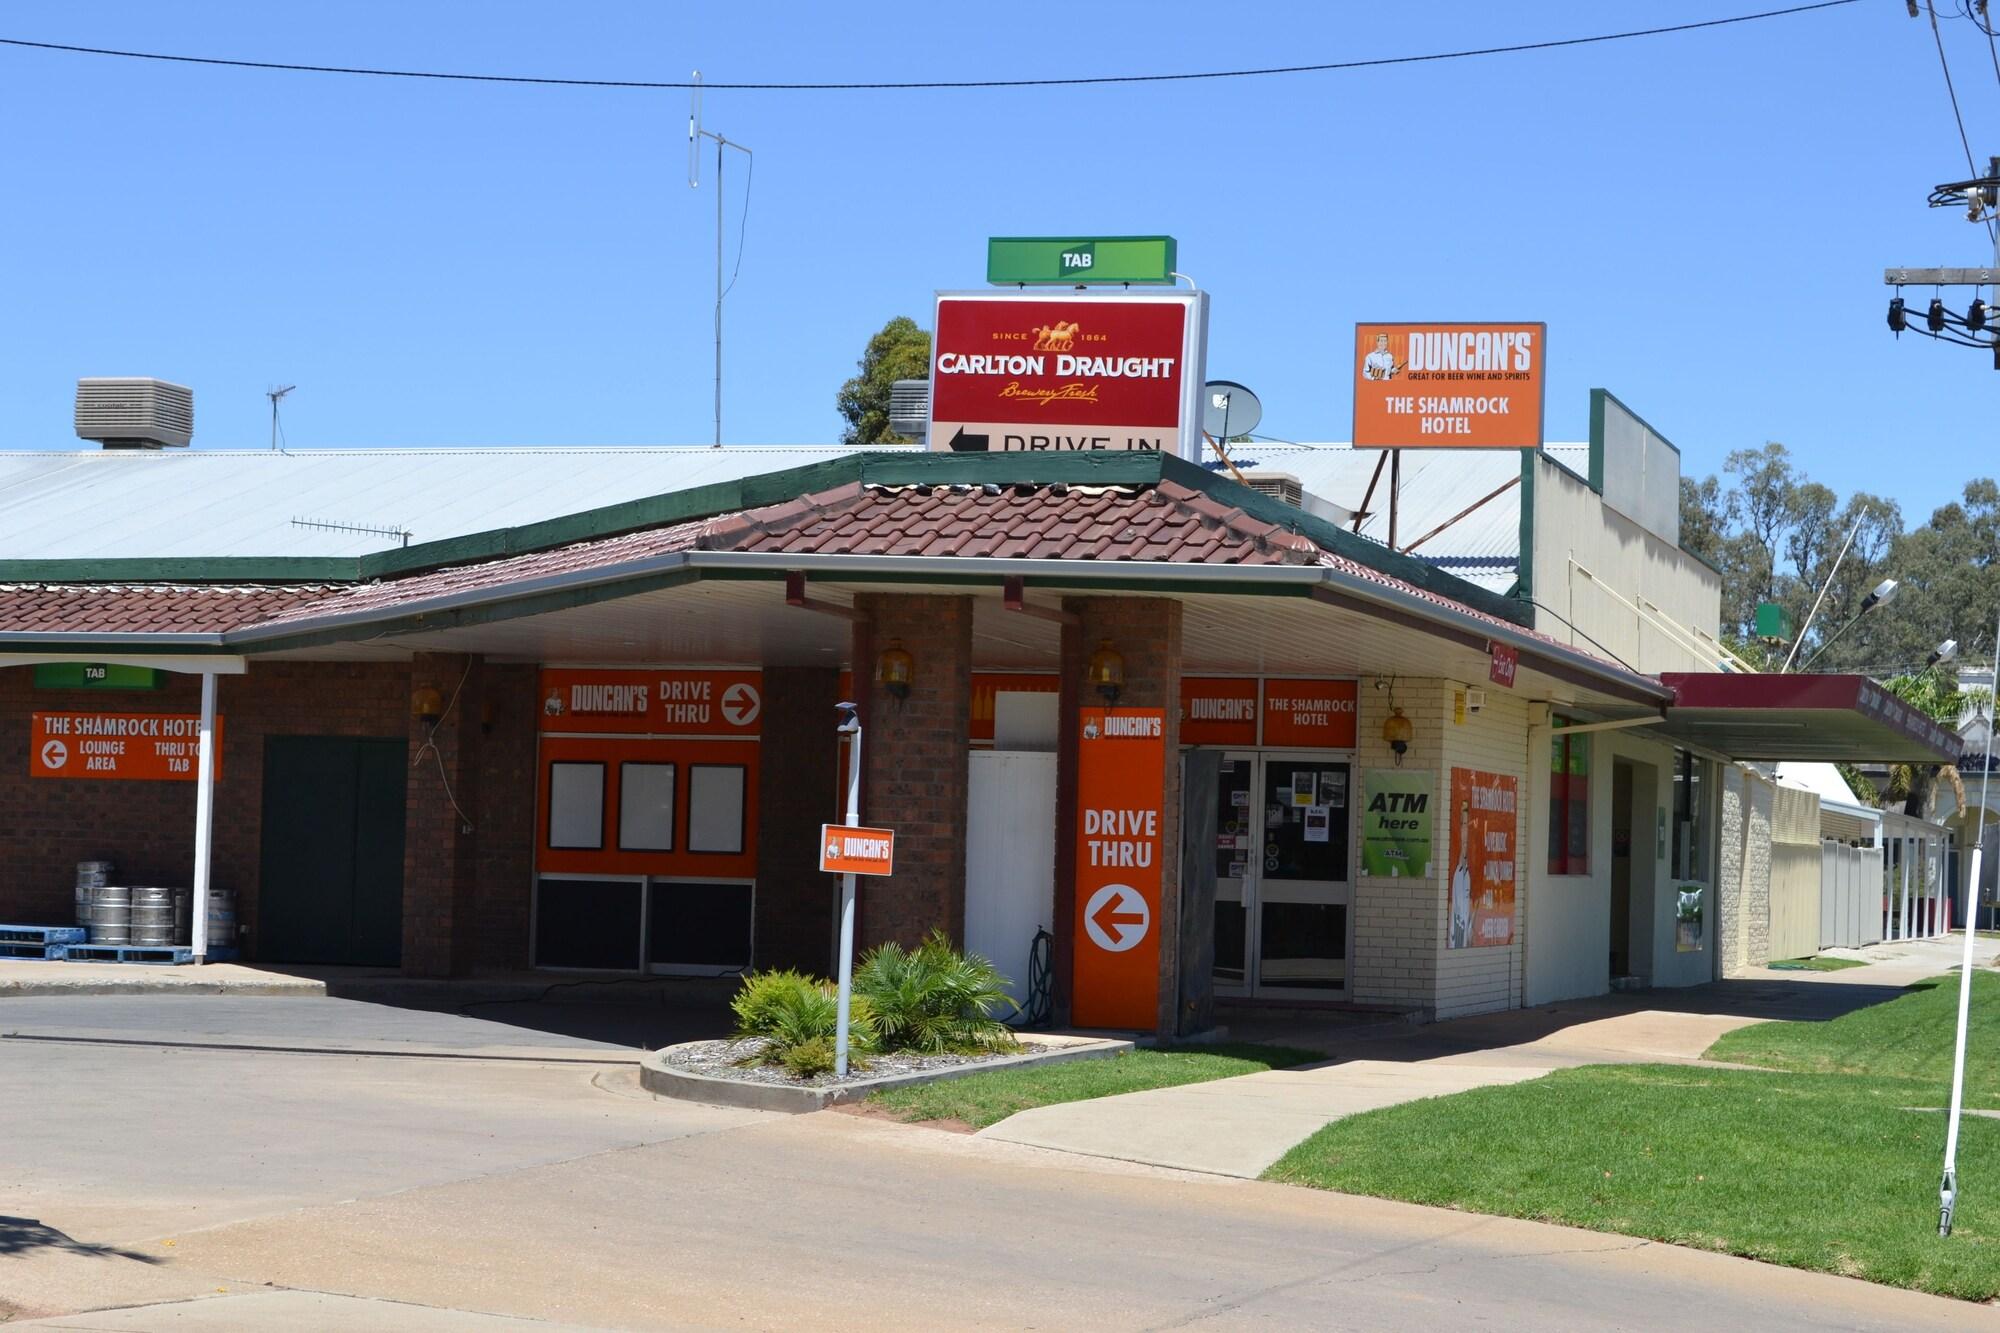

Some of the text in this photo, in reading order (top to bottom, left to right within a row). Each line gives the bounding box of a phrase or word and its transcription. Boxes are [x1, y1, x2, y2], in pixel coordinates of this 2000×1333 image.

[1062, 253, 1092, 267] TAB
[992, 332, 1107, 342] SINCE 1864
[1408, 332, 1531, 372] DUNCAN'S
[937, 353, 1175, 378] CARLTON DRAUGHT
[1407, 372, 1530, 381] GREAT FOR BEER WINE AND SPIRITS
[999, 381, 1099, 405] Brewery Fresh
[1385, 397, 1510, 415] THE SHAMROCK
[1421, 417, 1472, 435] HOTEL
[1004, 435, 1161, 451] DRIVE IN
[86, 667, 105, 679] TAB
[571, 685, 648, 713] DUNCAN'S
[660, 681, 711, 701] DRIVE
[665, 704, 710, 724] THRU
[1191, 698, 1254, 720] DUNCAN'S
[1269, 698, 1355, 713] THE SHAMROCK
[44, 717, 201, 737] THE SHAMROCK HOTE
[1104, 716, 1161, 737] DUNCAN'S
[1293, 713, 1329, 726] HOTEL
[79, 740, 125, 755] LOUNGE
[155, 742, 185, 757] THRU
[86, 757, 116, 771] AREA
[168, 758, 190, 772] TAB
[1368, 793, 1429, 814] ATM
[1084, 809, 1157, 836] DRIVE
[1378, 815, 1419, 830] here
[844, 837, 889, 860] DUNCAN'S
[1088, 840, 1151, 868] THRU
